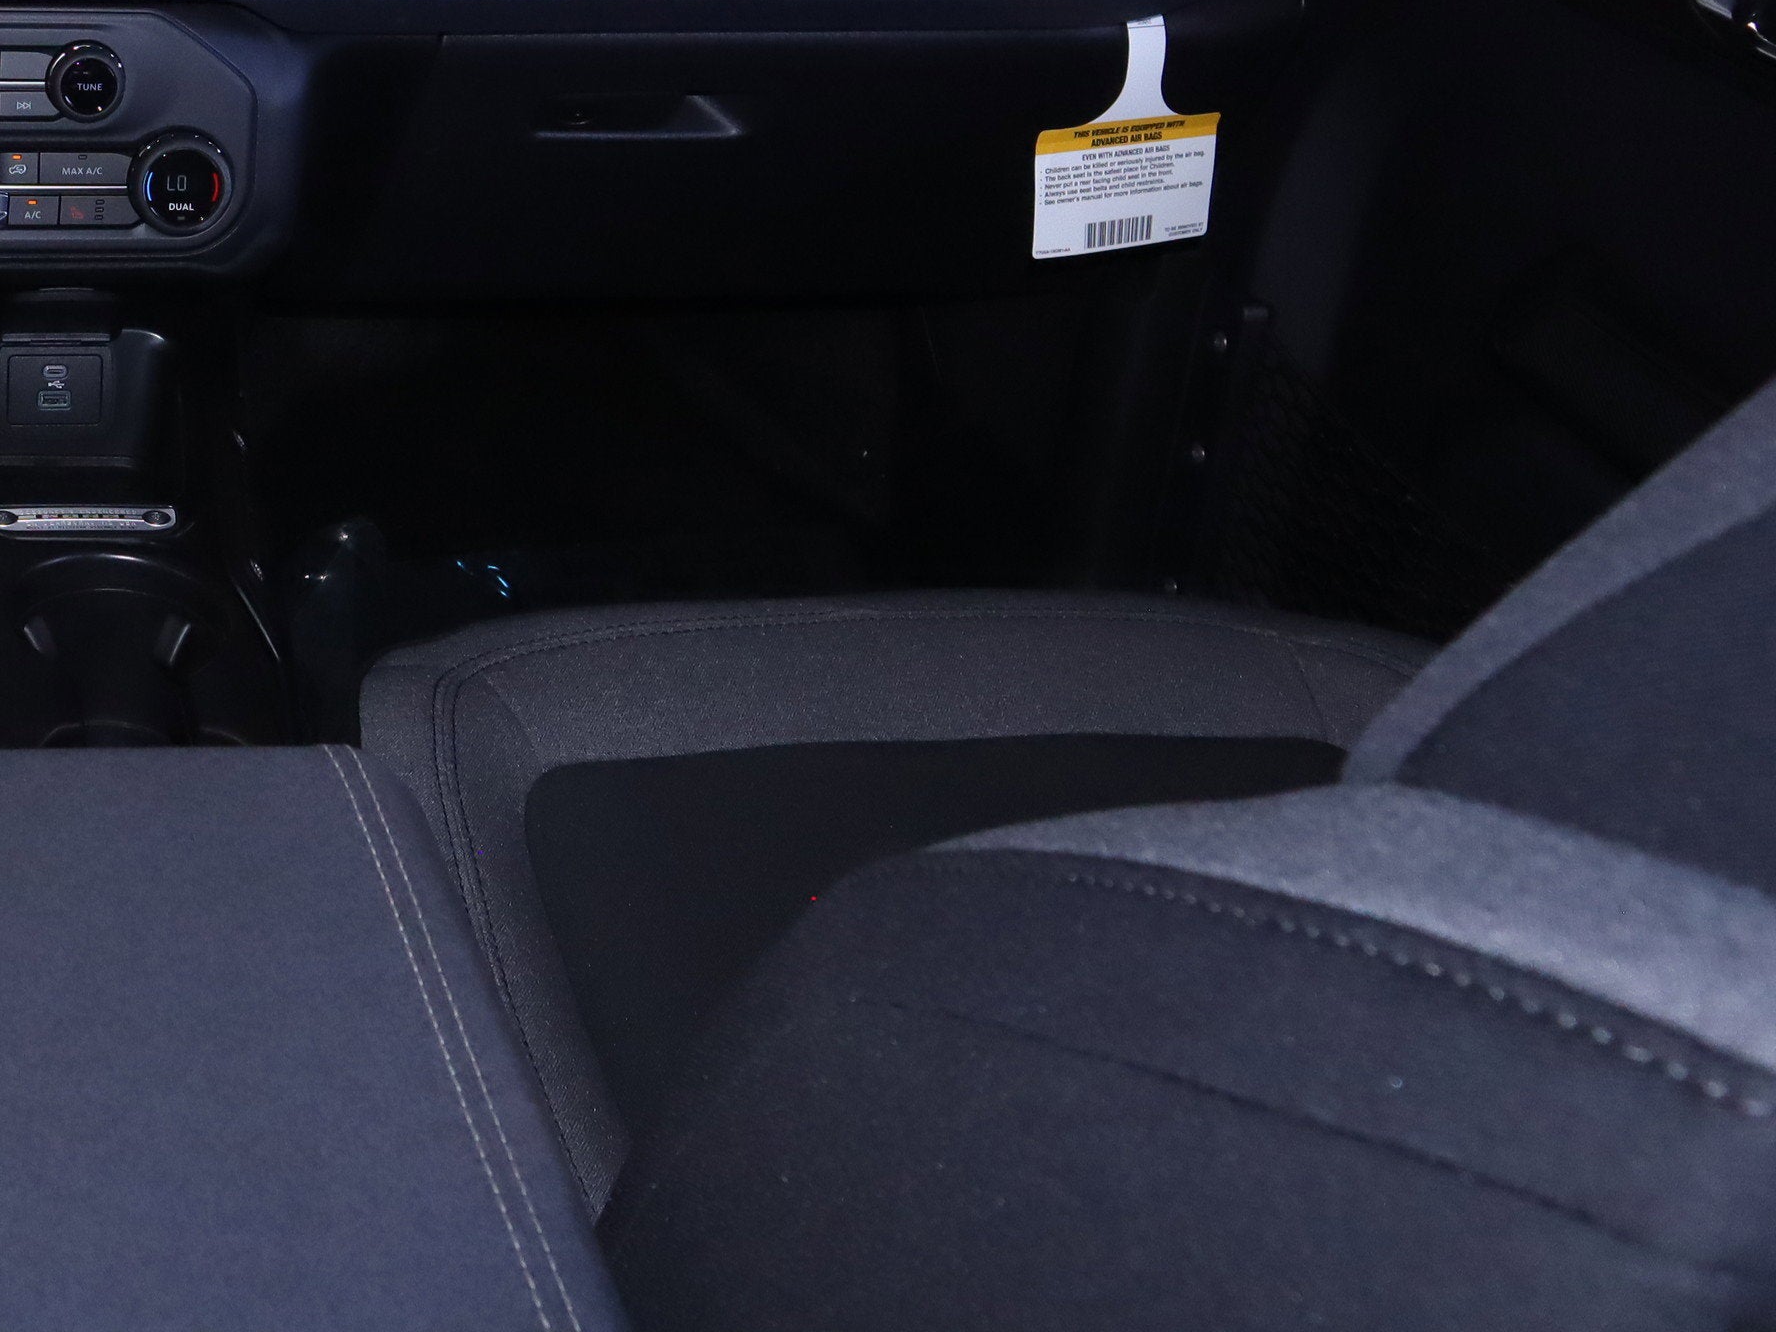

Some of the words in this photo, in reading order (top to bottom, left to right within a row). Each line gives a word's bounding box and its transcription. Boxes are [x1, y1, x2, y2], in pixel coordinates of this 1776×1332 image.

[77, 83, 103, 92] TUNE
[1074, 131, 1090, 139] THIS
[1091, 135, 1128, 147] ADVANCED
[1130, 134, 1142, 143] AIR
[1144, 132, 1162, 141] BAGS
[1082, 153, 1097, 161] EVEN
[1098, 151, 1113, 159] WITH
[1115, 148, 1143, 157] ADVANCED
[61, 167, 84, 175] MAX
[86, 167, 103, 176] A/C
[166, 174, 187, 191] LO
[168, 203, 194, 211] DUAL
[24, 210, 41, 220] A/C
